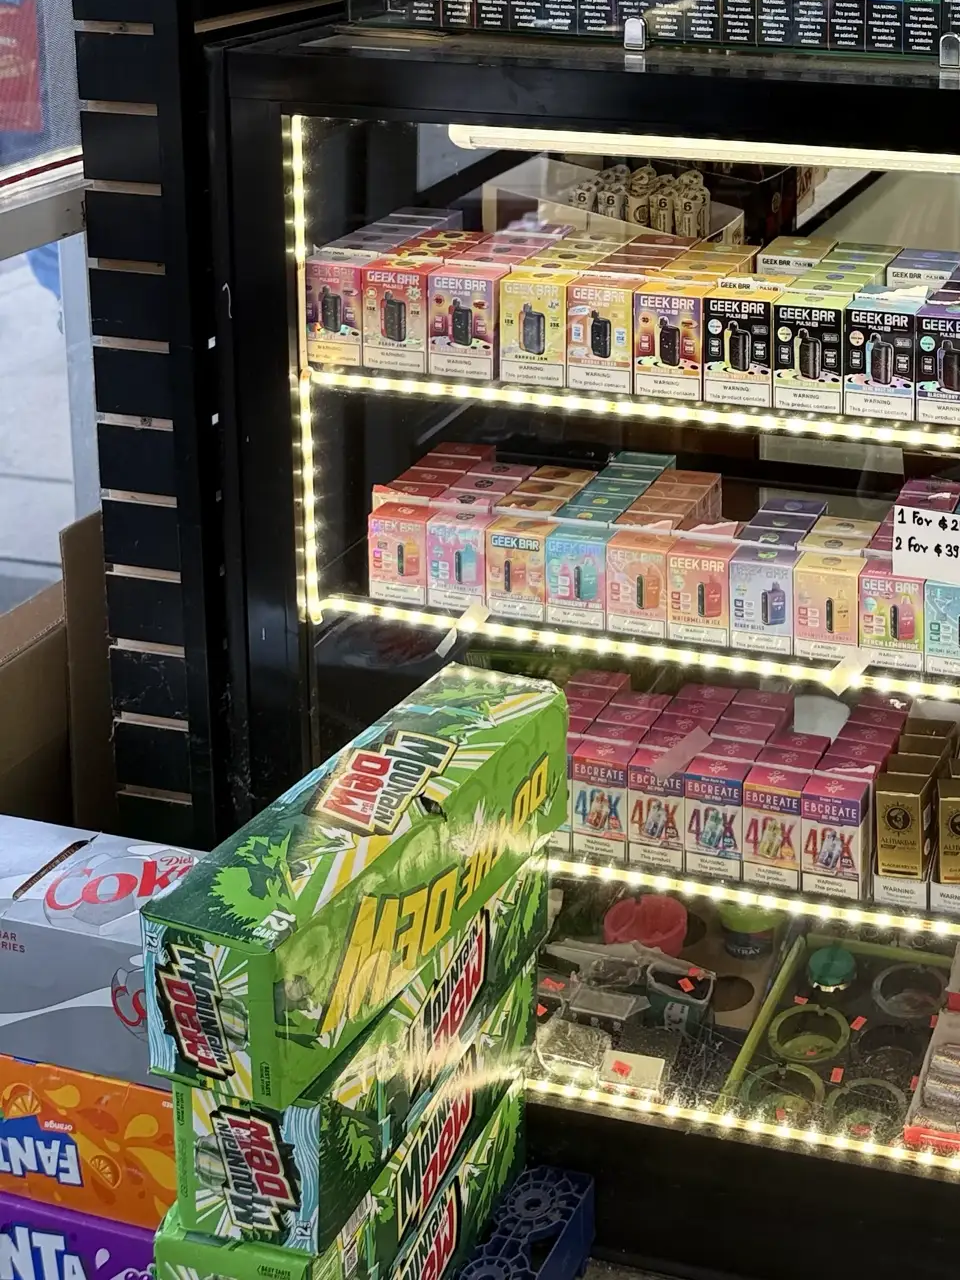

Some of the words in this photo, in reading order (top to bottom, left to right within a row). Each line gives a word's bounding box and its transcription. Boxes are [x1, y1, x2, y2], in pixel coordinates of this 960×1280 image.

[366, 271, 396, 284] GEEK
[397, 274, 420, 287] BAR
[434, 276, 462, 290] GEEK
[464, 279, 487, 293] BAR
[709, 300, 740, 313] GEEK
[741, 302, 765, 315] BAR
[897, 509, 907, 524] 1
[491, 535, 517, 547] GEEK
[519, 538, 540, 551] BAR
[895, 537, 902, 550] 2
[574, 763, 624, 782] EBCREATE
[630, 775, 681, 790] EBCREATE
[688, 782, 739, 798] EBCREATE
[746, 790, 798, 809] EBCREATE
[804, 803, 857, 820] EBCREATE
[261, 909, 296, 932] 12
[252, 927, 279, 941] CANS
[44, 1121, 73, 1131] orange
